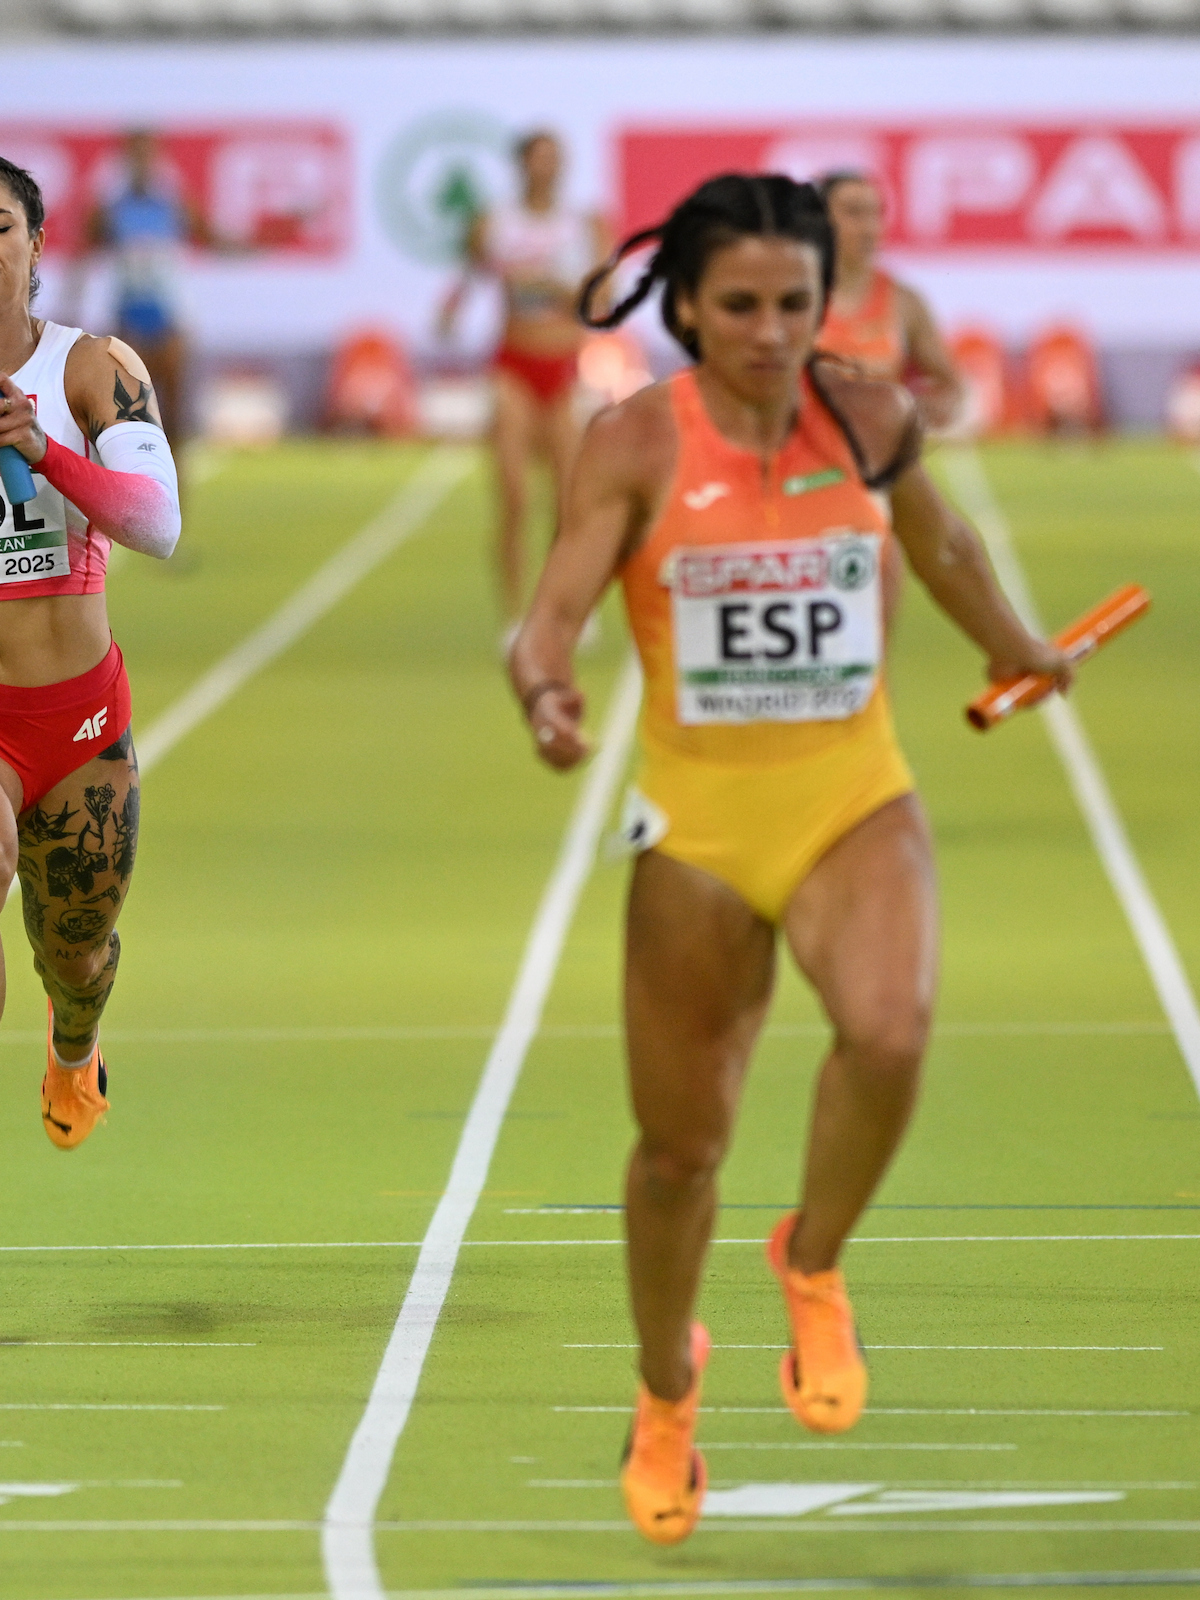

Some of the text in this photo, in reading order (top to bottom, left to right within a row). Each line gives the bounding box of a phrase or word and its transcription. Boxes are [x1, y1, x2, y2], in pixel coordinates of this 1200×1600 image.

[5, 553, 55, 576] 2025
[720, 602, 842, 660] ESP
[72, 706, 108, 742] 4F
